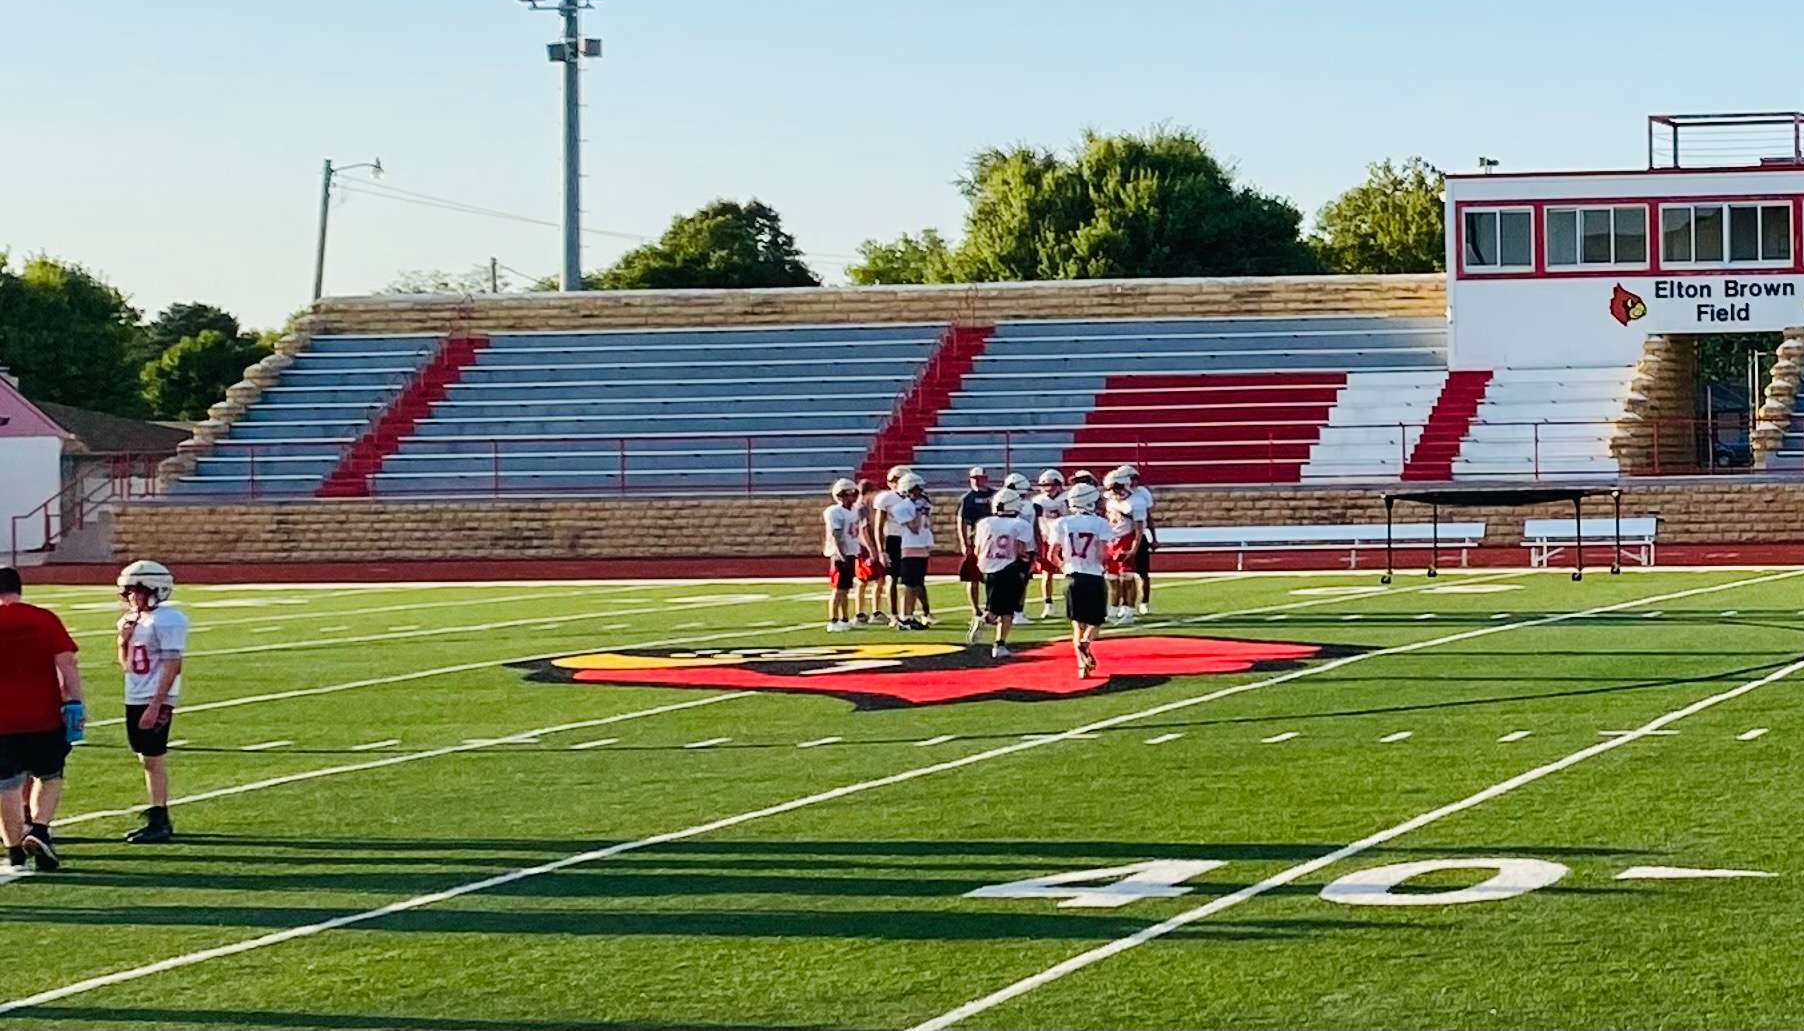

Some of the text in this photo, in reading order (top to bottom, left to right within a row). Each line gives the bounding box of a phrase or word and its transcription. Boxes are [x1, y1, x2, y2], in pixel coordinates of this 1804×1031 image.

[1654, 279, 1795, 299] Elton Brown
[1696, 302, 1750, 322] Field
[1068, 531, 1095, 560] 17
